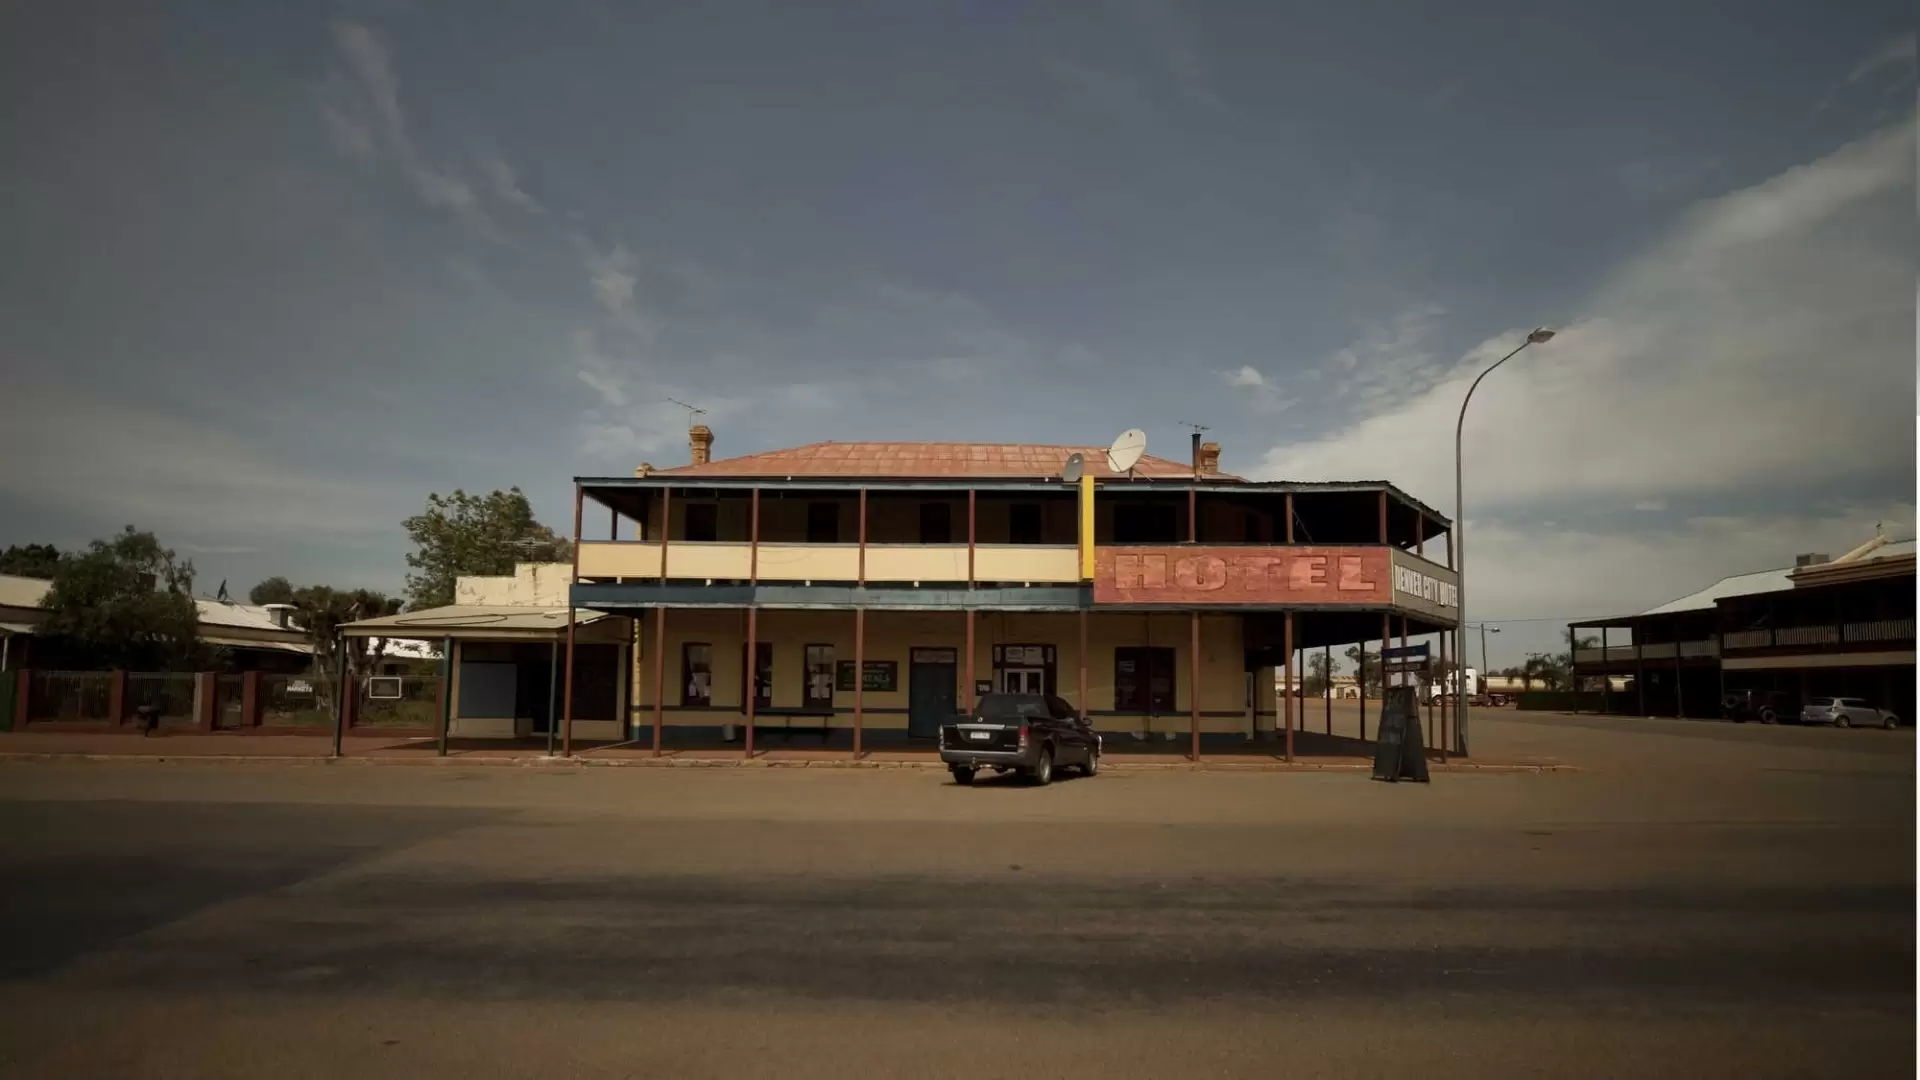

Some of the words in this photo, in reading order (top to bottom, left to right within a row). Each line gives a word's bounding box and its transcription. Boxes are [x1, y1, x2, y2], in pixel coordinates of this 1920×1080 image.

[1113, 553, 1376, 592] HOTEL
[1394, 564, 1423, 597] DENVER
[1423, 575, 1438, 602] CITY
